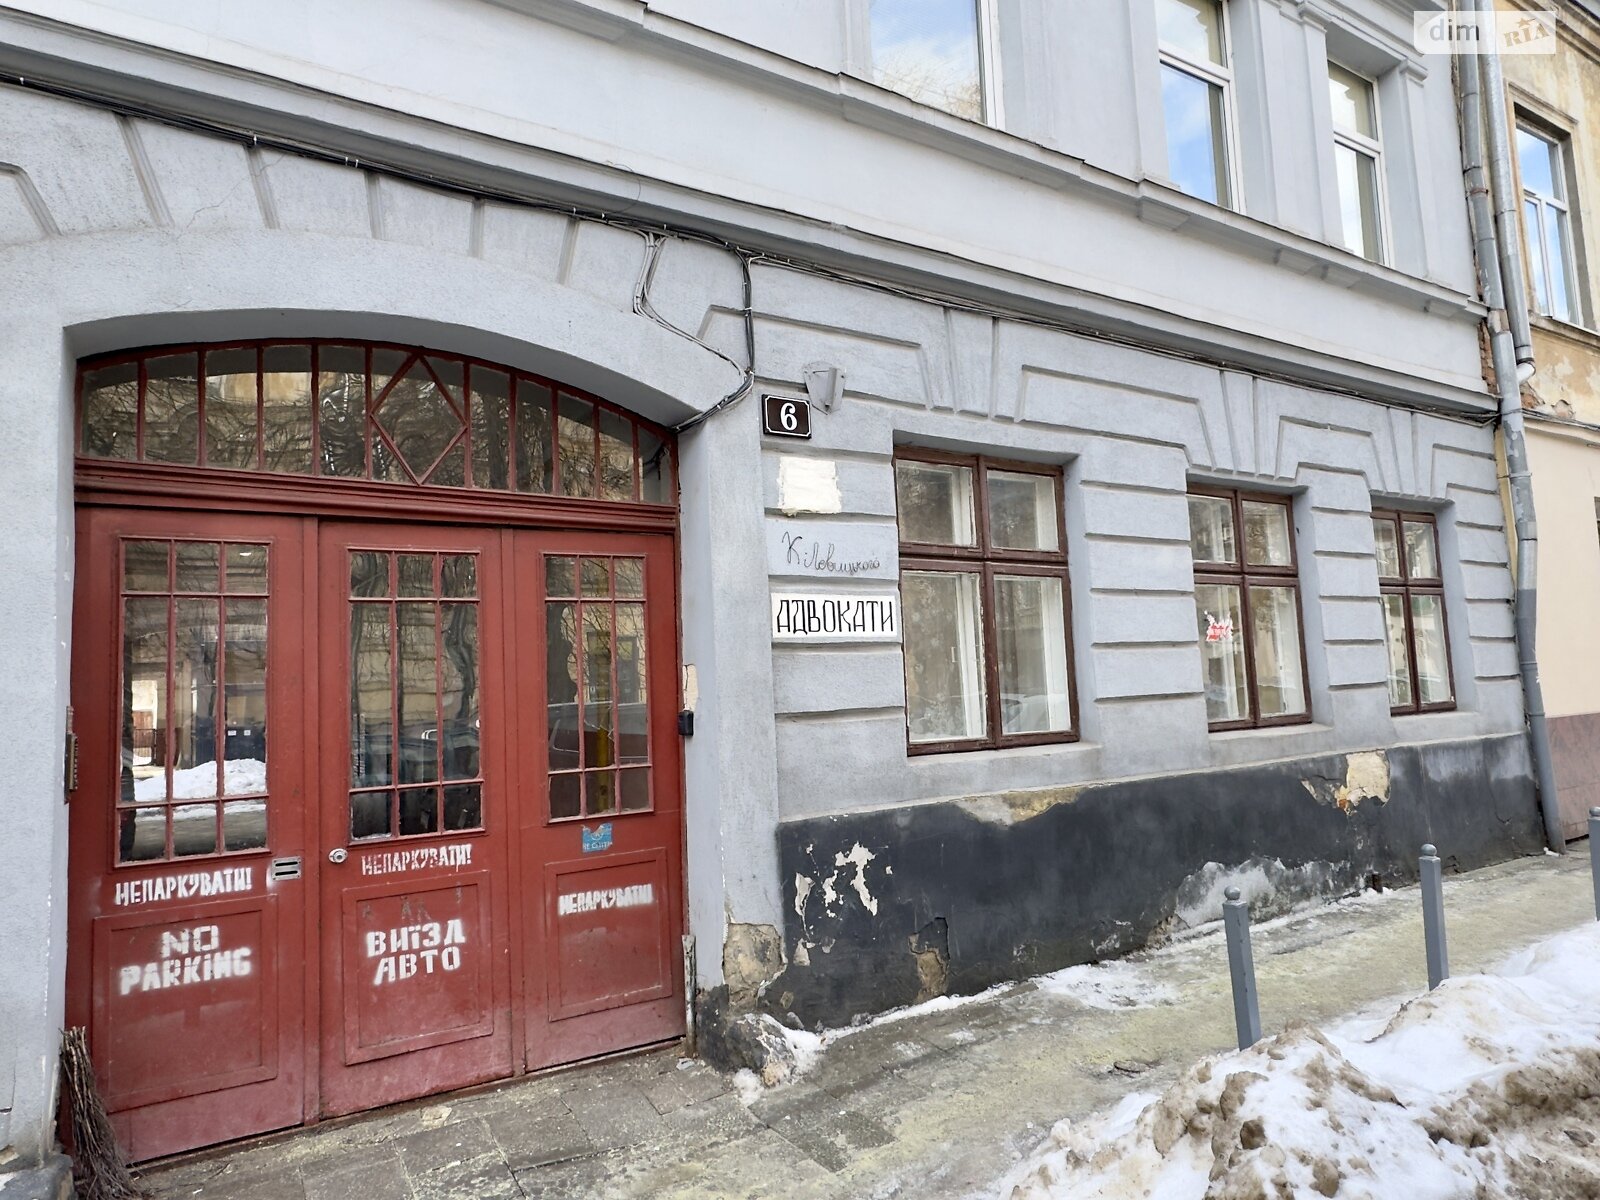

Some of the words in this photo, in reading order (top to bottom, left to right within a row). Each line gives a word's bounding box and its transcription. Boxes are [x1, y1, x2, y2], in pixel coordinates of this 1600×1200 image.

[780, 402, 798, 431] 6
[776, 600, 894, 635] АДВОКАТИ
[161, 925, 220, 958] NO
[119, 947, 252, 995] PARKING
[373, 946, 461, 986] АВТО
